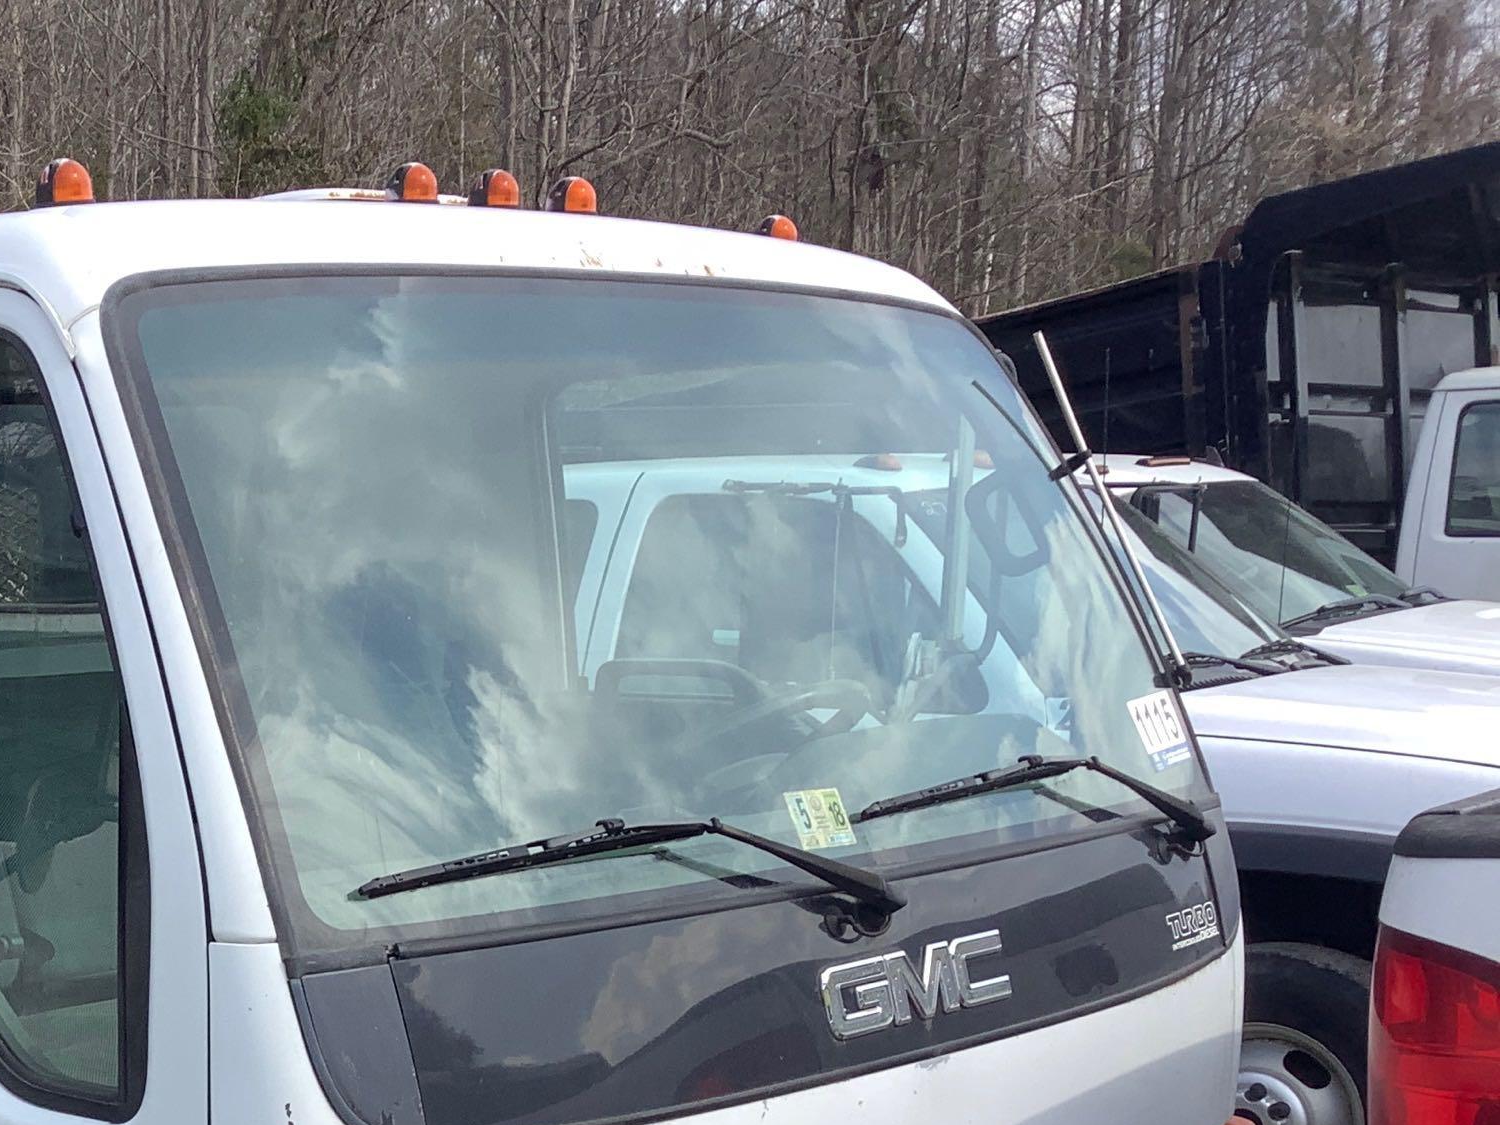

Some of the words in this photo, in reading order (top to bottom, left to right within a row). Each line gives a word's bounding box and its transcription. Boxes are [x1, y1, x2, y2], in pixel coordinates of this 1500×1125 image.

[1134, 698, 1180, 747] 1115
[795, 797, 813, 829] 5
[828, 801, 846, 827] 18
[1165, 901, 1218, 940] TURBO
[820, 929, 1013, 1042] GMC
